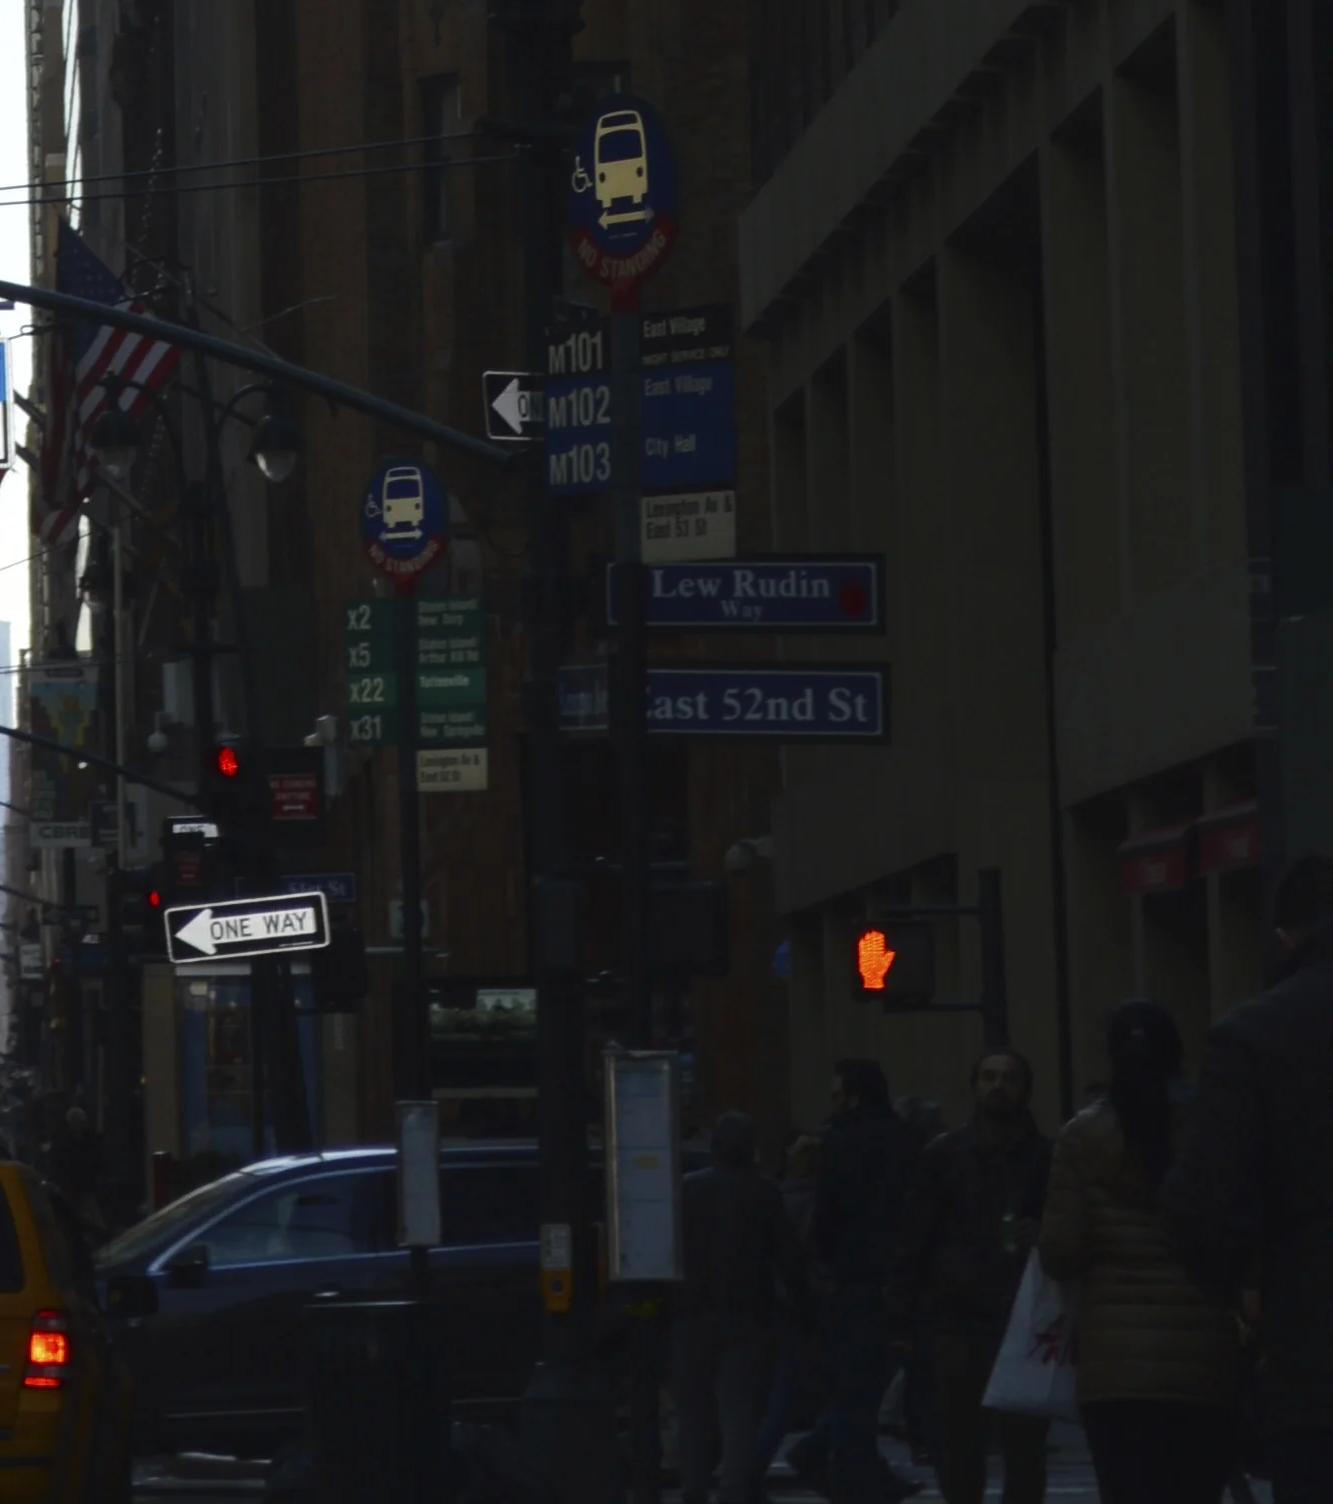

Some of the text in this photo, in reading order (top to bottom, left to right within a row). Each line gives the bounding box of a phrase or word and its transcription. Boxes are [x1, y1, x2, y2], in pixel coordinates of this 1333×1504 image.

[578, 229, 666, 281] NO STANDING
[548, 330, 603, 375] M101
[548, 385, 611, 429] M102
[549, 442, 611, 485] M103
[650, 569, 831, 599] Lew Rudin
[719, 599, 765, 622] Way
[722, 685, 817, 722] 52nd
[826, 687, 869, 723] St
[210, 909, 307, 941] ONE WAY
